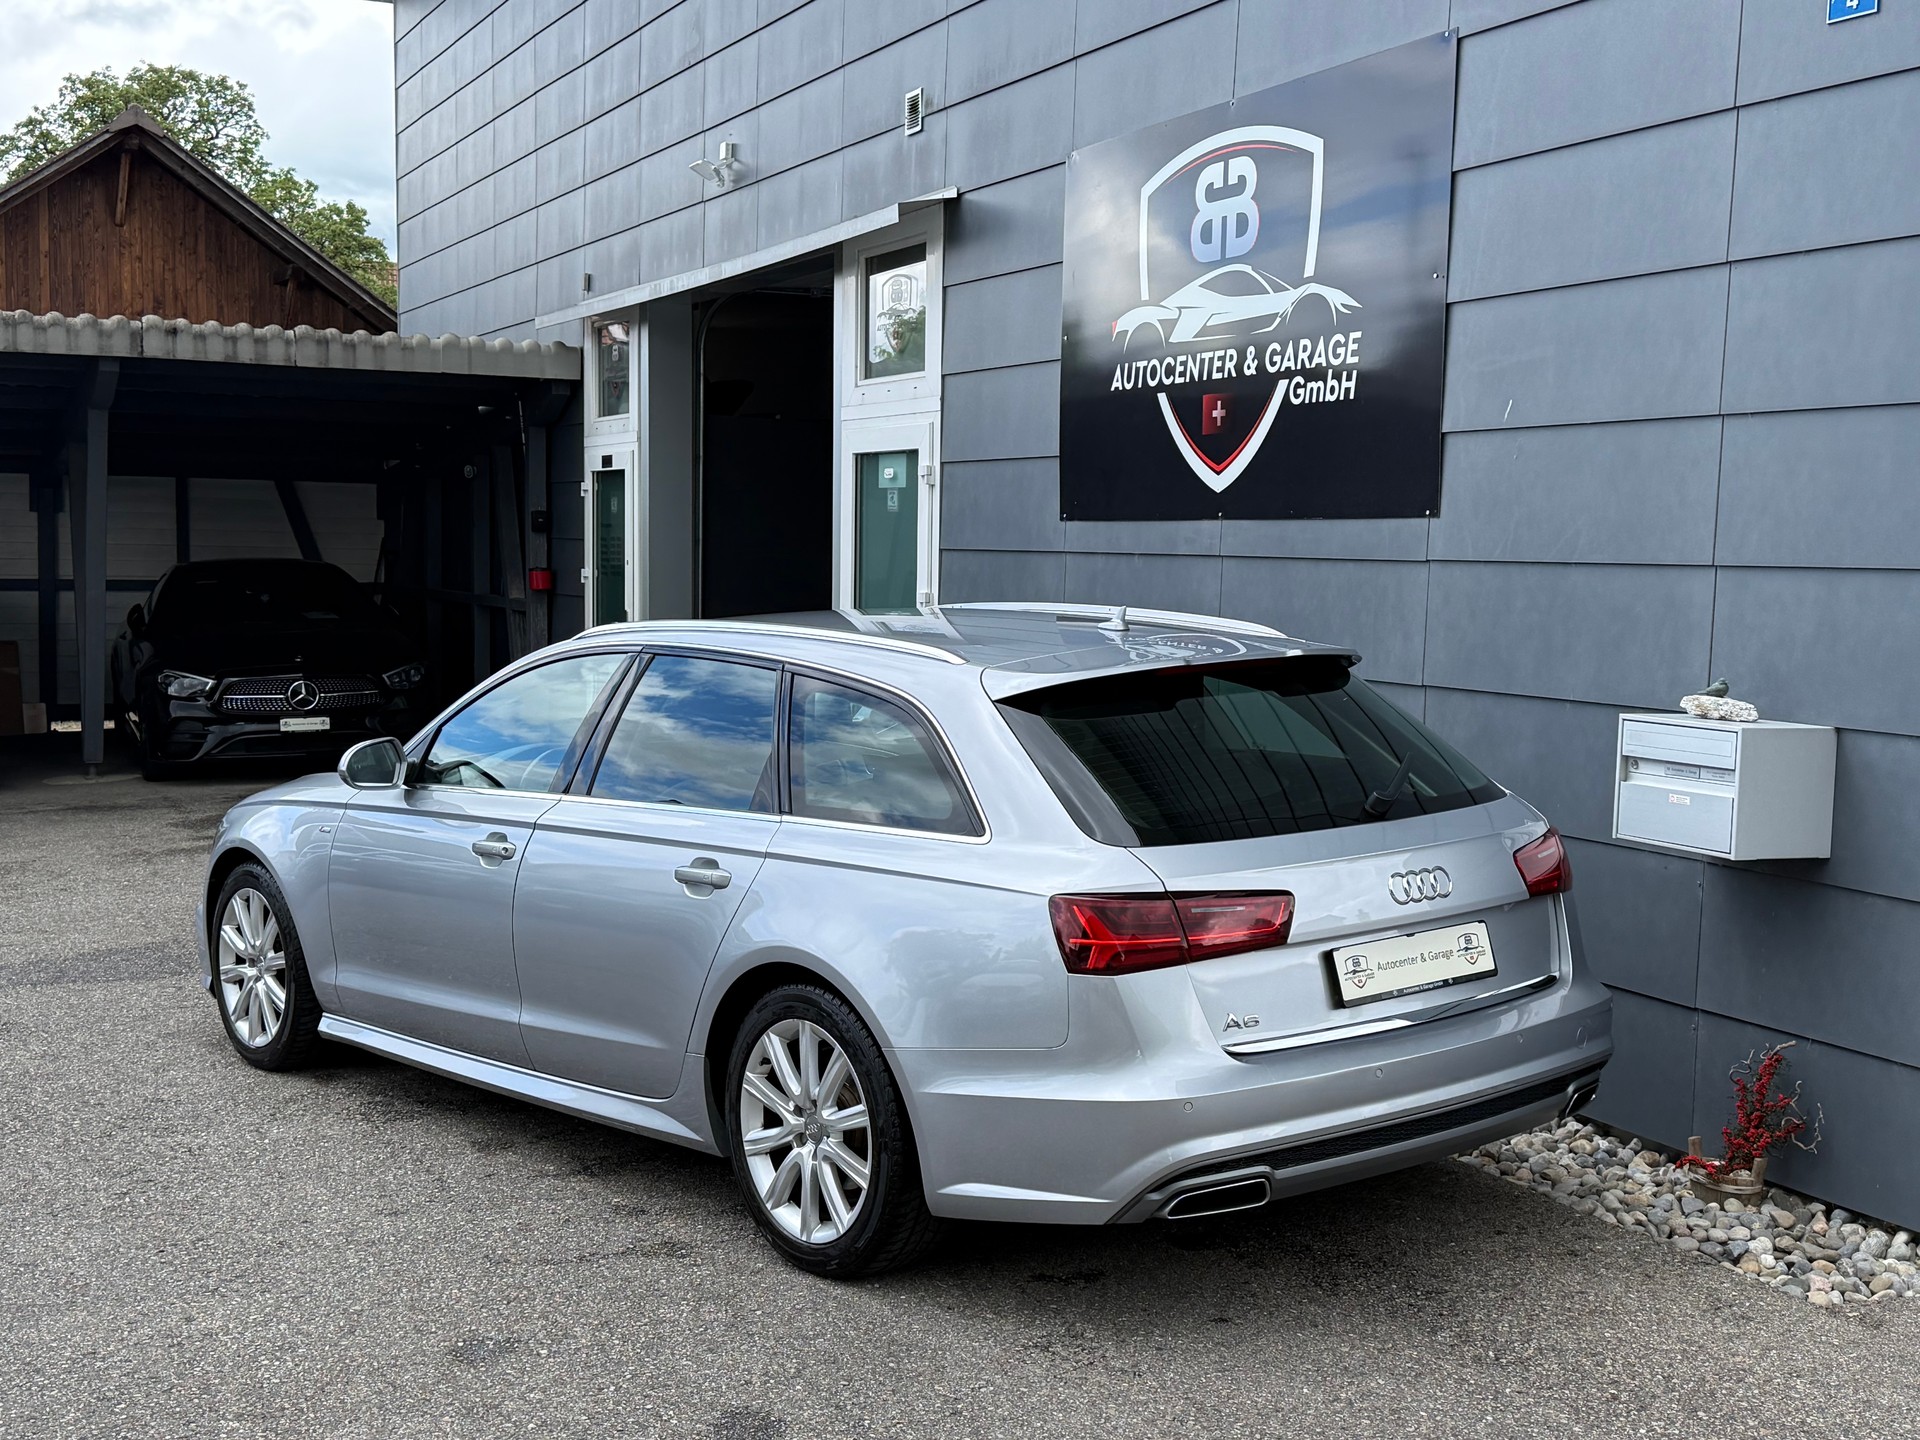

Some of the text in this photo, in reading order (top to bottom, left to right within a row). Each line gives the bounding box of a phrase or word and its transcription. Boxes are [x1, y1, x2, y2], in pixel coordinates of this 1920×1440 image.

[1110, 331, 1363, 392] AUTOCENTER & GARAGE
[1289, 369, 1358, 406] GmbH
[1377, 956, 1419, 972] Autocenter
[1419, 952, 1427, 963] &
[1427, 949, 1455, 961] Garage
[1222, 1012, 1260, 1032] A6
